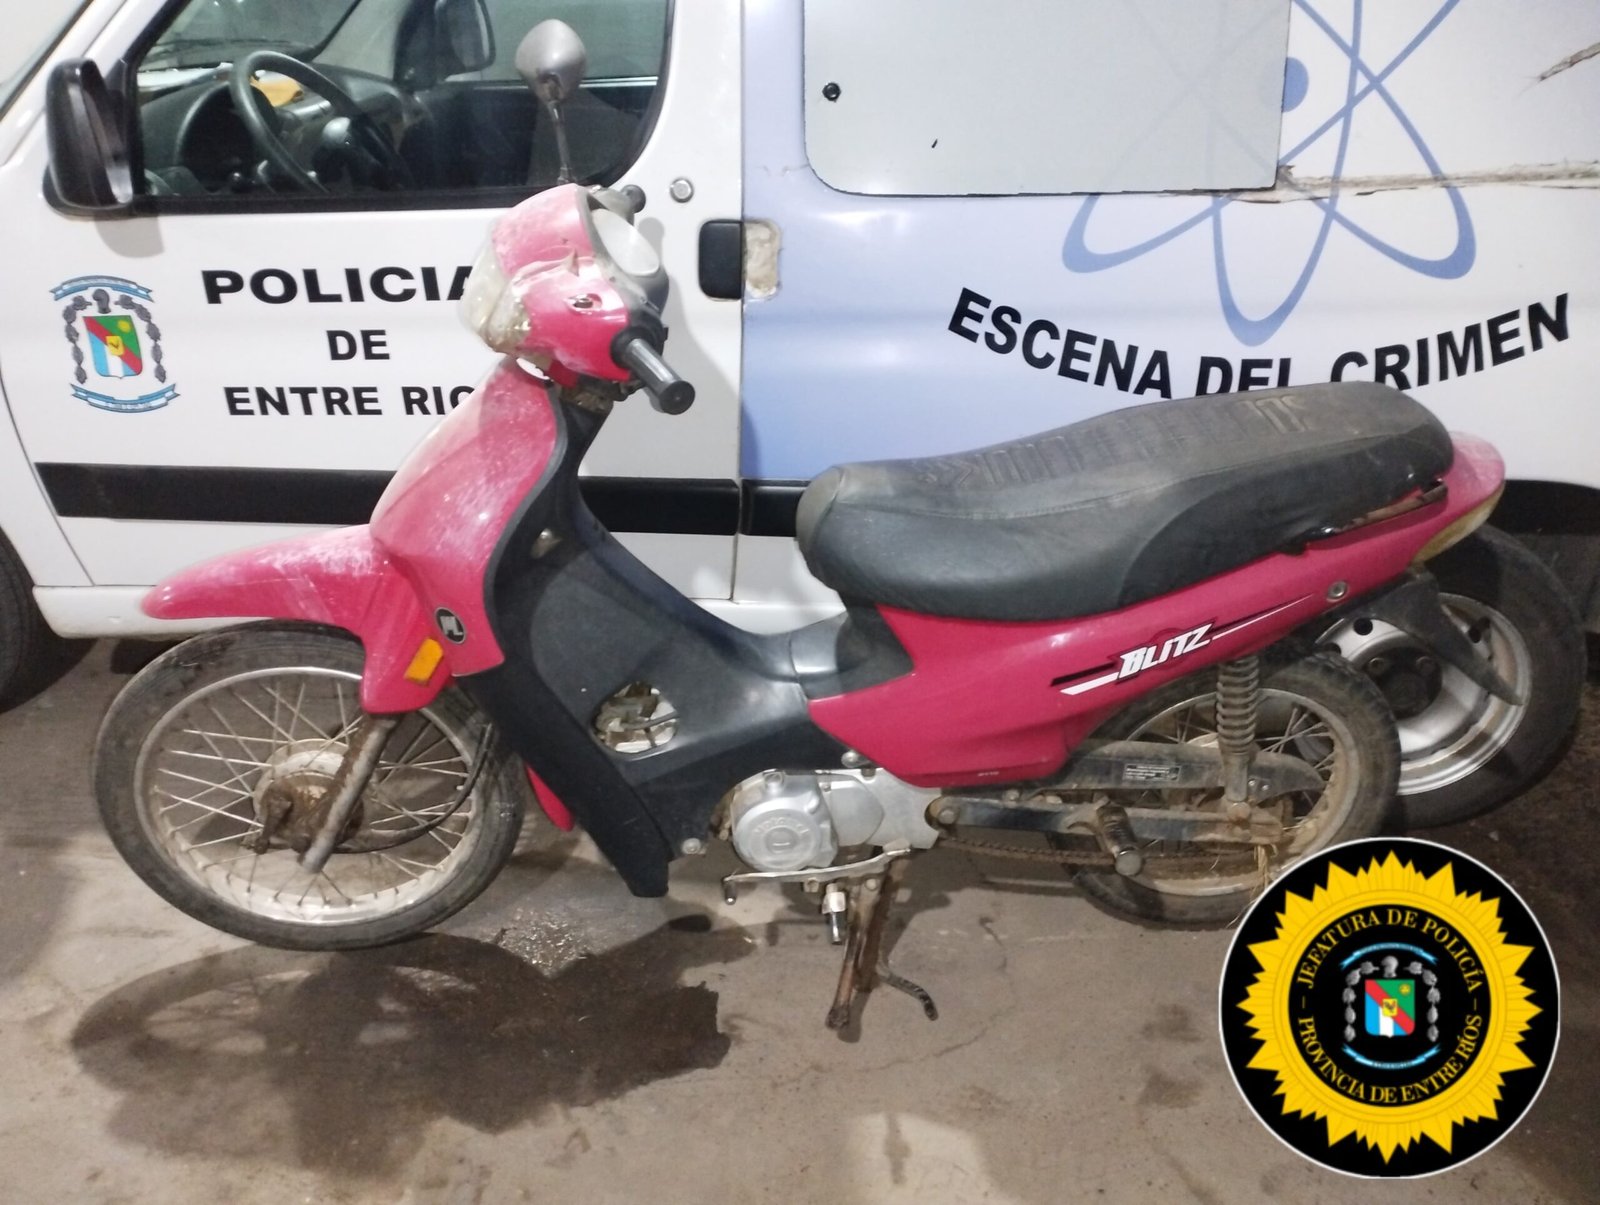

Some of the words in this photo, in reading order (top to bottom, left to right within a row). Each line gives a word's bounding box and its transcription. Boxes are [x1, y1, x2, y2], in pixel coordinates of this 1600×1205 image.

[326, 329, 390, 361] DE
[947, 286, 1172, 400] ESCENA
[1330, 292, 1569, 392] CRIMEN
[223, 386, 383, 416] ENTRE
[1118, 622, 1213, 679] BLITZ
